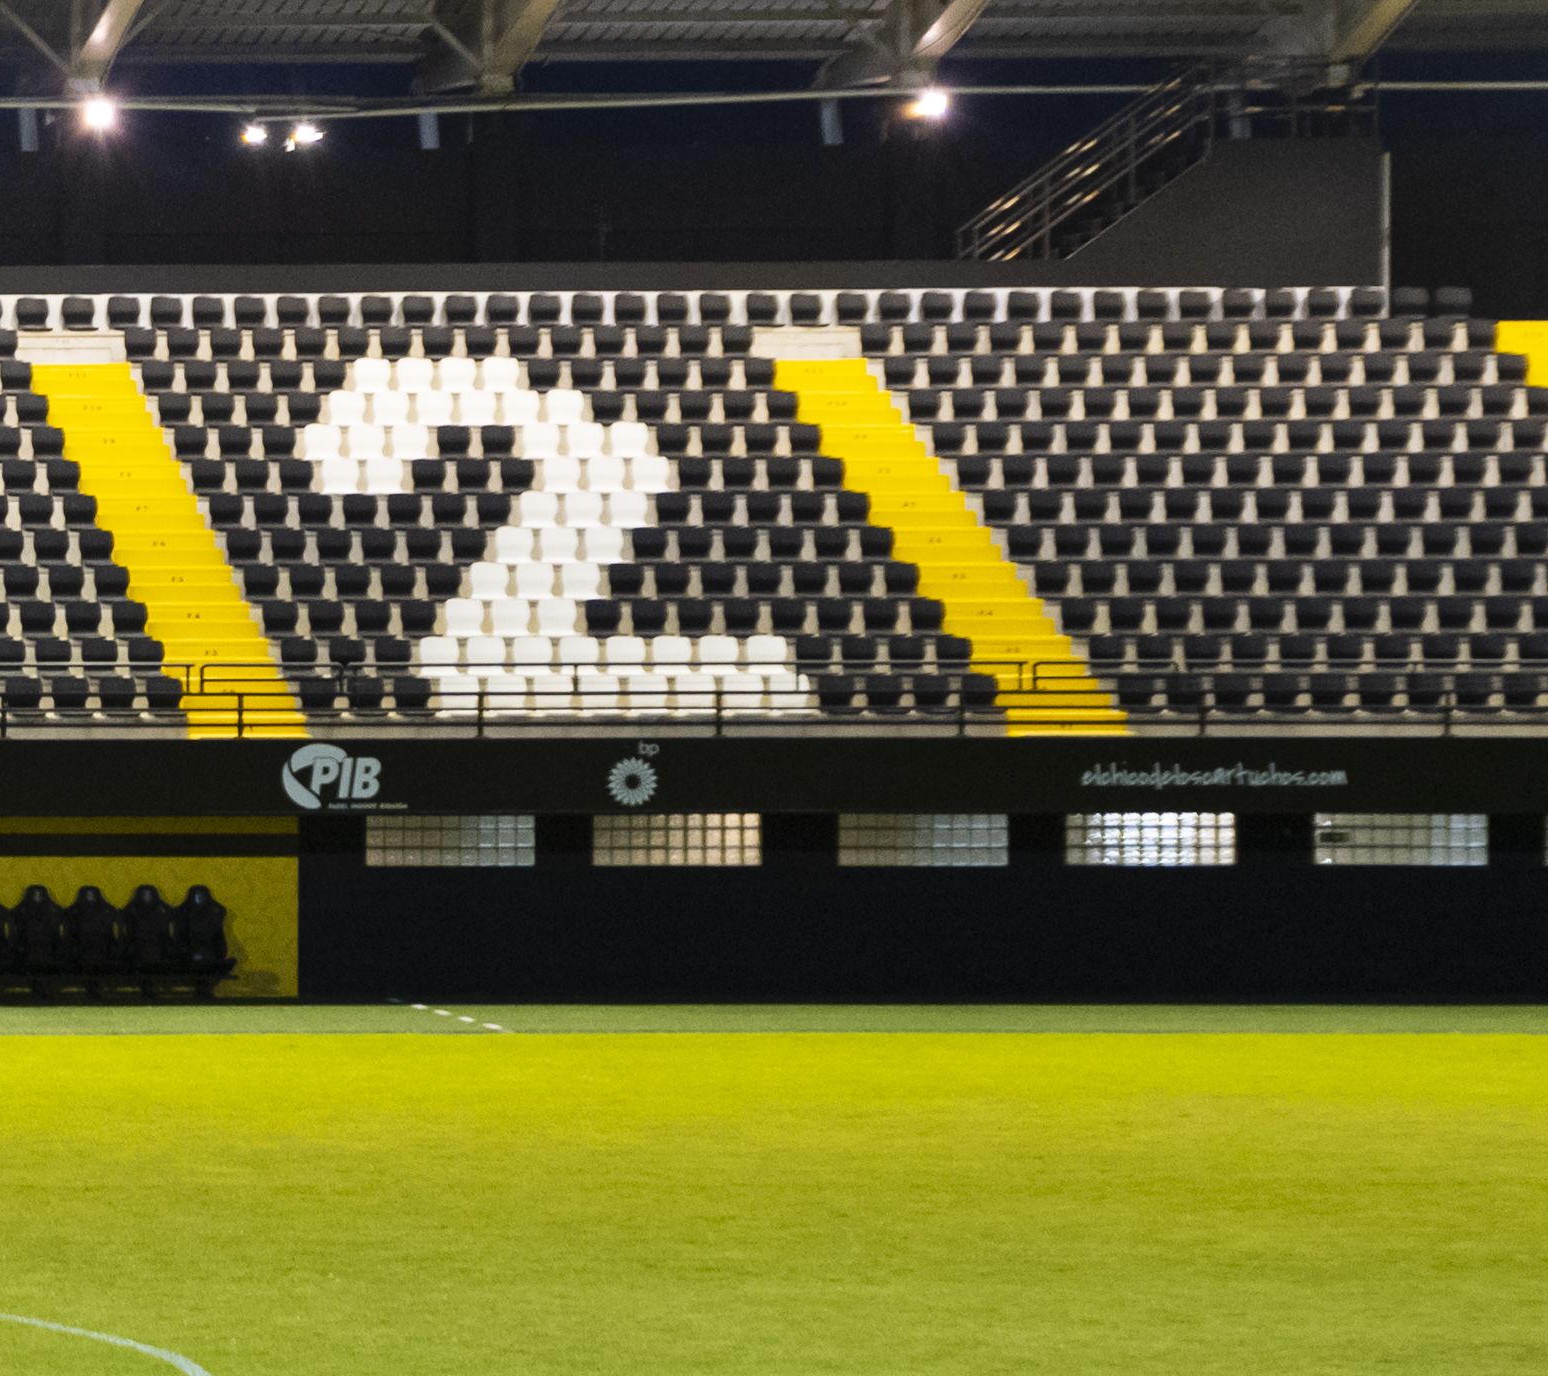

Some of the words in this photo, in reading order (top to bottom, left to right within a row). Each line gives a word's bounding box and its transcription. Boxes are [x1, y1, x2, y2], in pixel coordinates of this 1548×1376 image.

[302, 356, 812, 715] 2
[638, 740, 659, 757] bp
[310, 756, 382, 799] PIB
